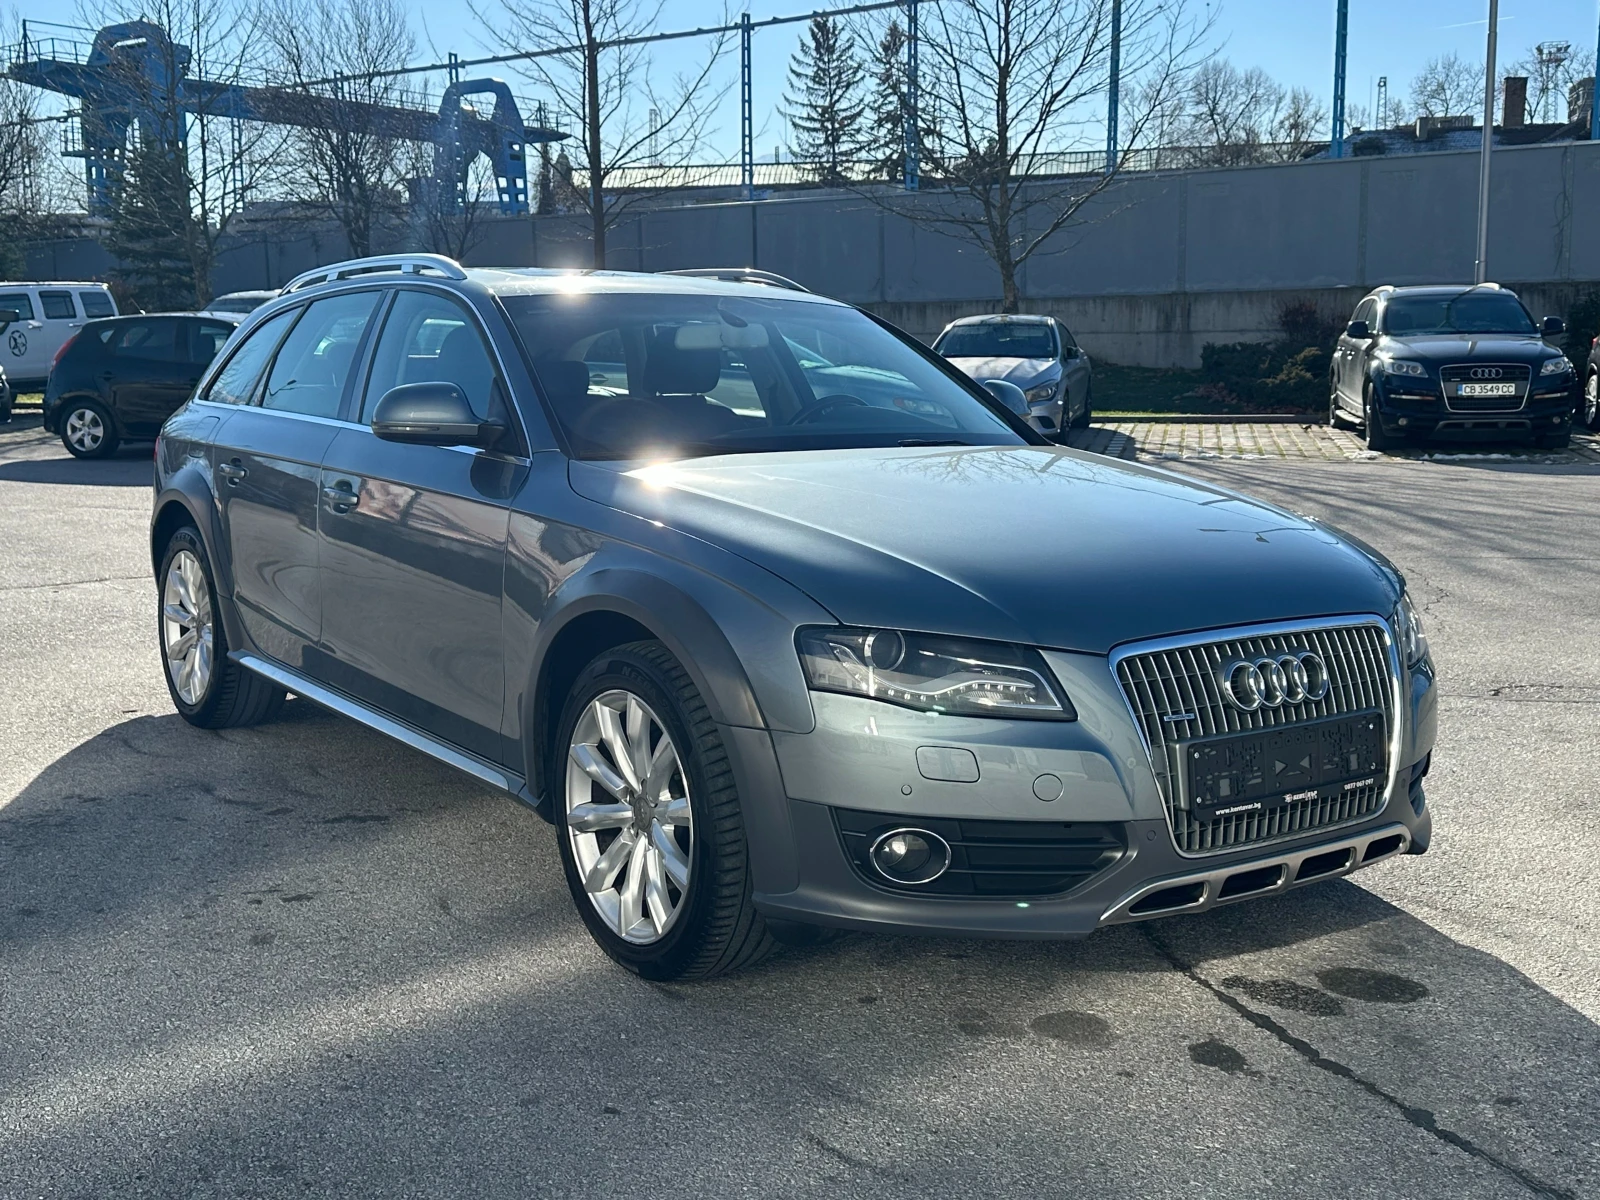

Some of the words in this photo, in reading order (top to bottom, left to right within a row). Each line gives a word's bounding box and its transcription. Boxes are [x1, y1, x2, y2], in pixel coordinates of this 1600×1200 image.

[1464, 385, 1476, 394] CB
[1477, 385, 1500, 394] 3549
[1501, 385, 1514, 394] CC
